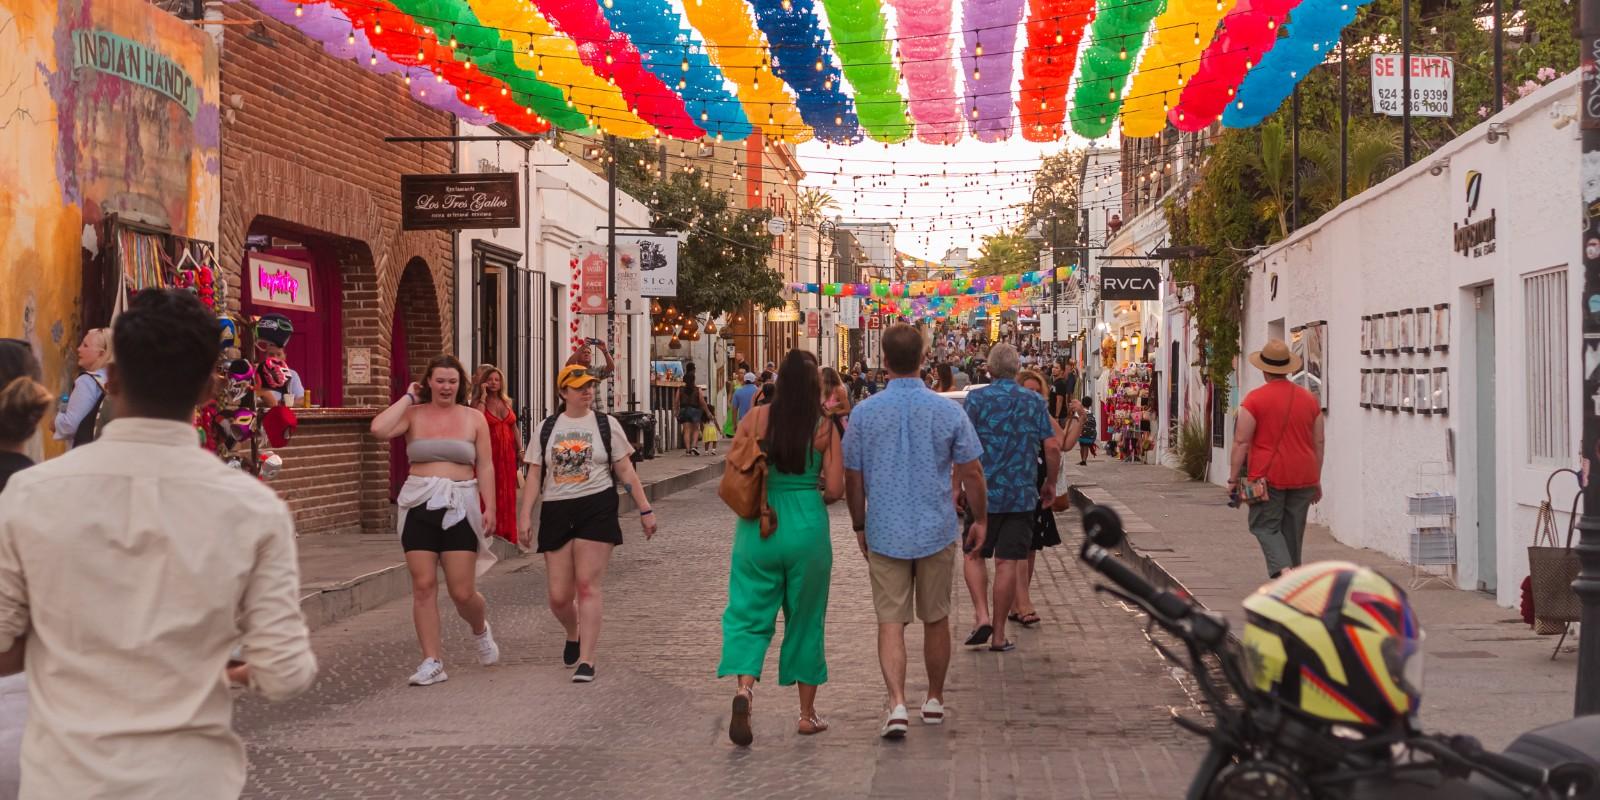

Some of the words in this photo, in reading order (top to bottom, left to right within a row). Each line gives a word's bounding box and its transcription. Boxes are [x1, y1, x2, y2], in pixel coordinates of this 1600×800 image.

[79, 32, 140, 80] INDIAN
[144, 49, 191, 105] HANDS
[1375, 57, 1394, 77] SE
[1378, 88, 1397, 99] 624
[1423, 89, 1448, 100] 9399
[1380, 100, 1397, 111] 624
[414, 194, 440, 210] Los
[442, 194, 468, 209] Tres
[469, 192, 508, 212] Gallos
[643, 277, 674, 286] SICA
[1104, 278, 1156, 290] RVCA
